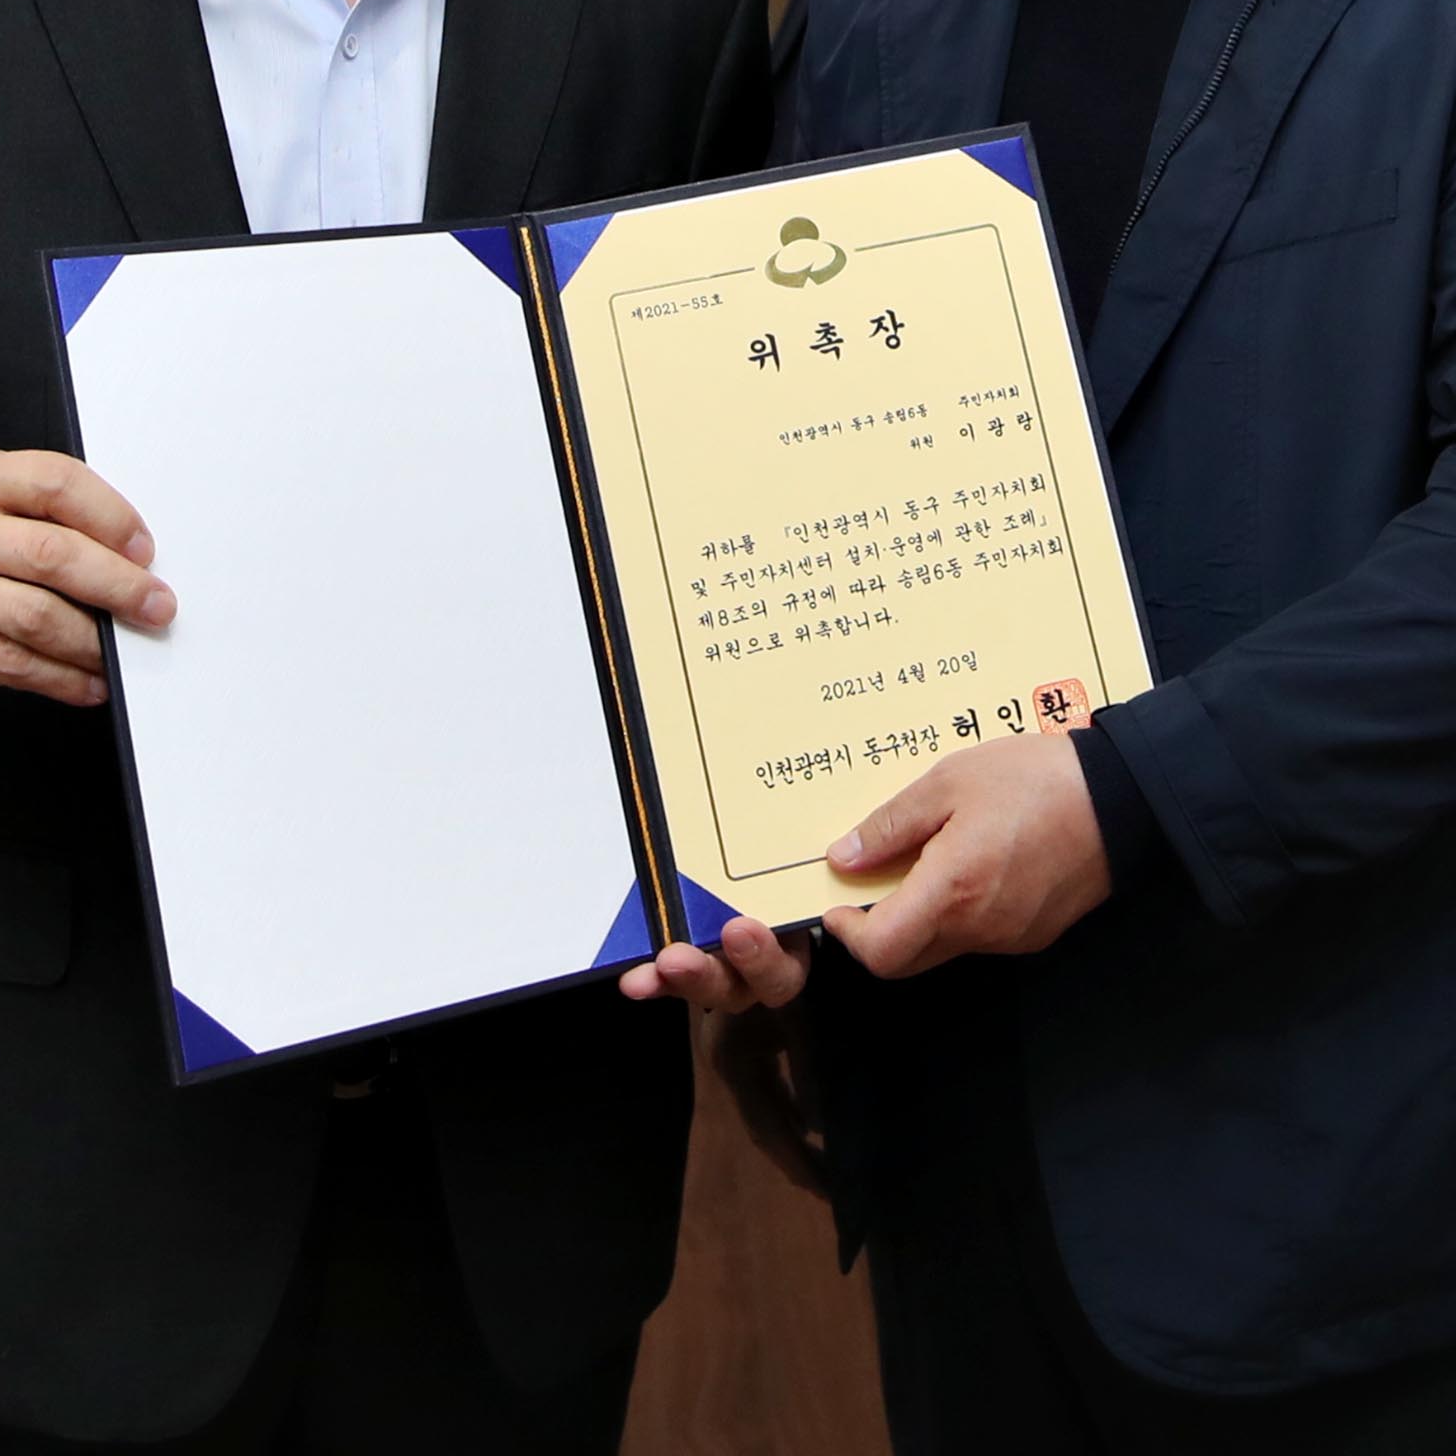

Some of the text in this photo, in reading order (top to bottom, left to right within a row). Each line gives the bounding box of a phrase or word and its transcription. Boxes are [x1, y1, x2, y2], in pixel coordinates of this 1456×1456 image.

[778, 420, 843, 446] 인천광역시
[850, 414, 876, 432] 동구
[957, 384, 1021, 408] 주민자치회
[909, 433, 935, 451] 위원
[700, 533, 756, 562] 귀하를
[902, 495, 941, 521] 동구
[952, 473, 1047, 509] 주민자치회
[690, 578, 709, 600] 및
[720, 551, 833, 592] 주민자치센터
[954, 518, 992, 544] 관한
[698, 535, 1064, 630] 제8조의 규정에 따라 송림6동 주민자치회
[704, 607, 900, 663] 위원으로 위촉합니다.
[819, 650, 979, 703] 2021년 4월 20일
[755, 743, 854, 790] 인천광역시
[862, 724, 941, 767] 동구청장
